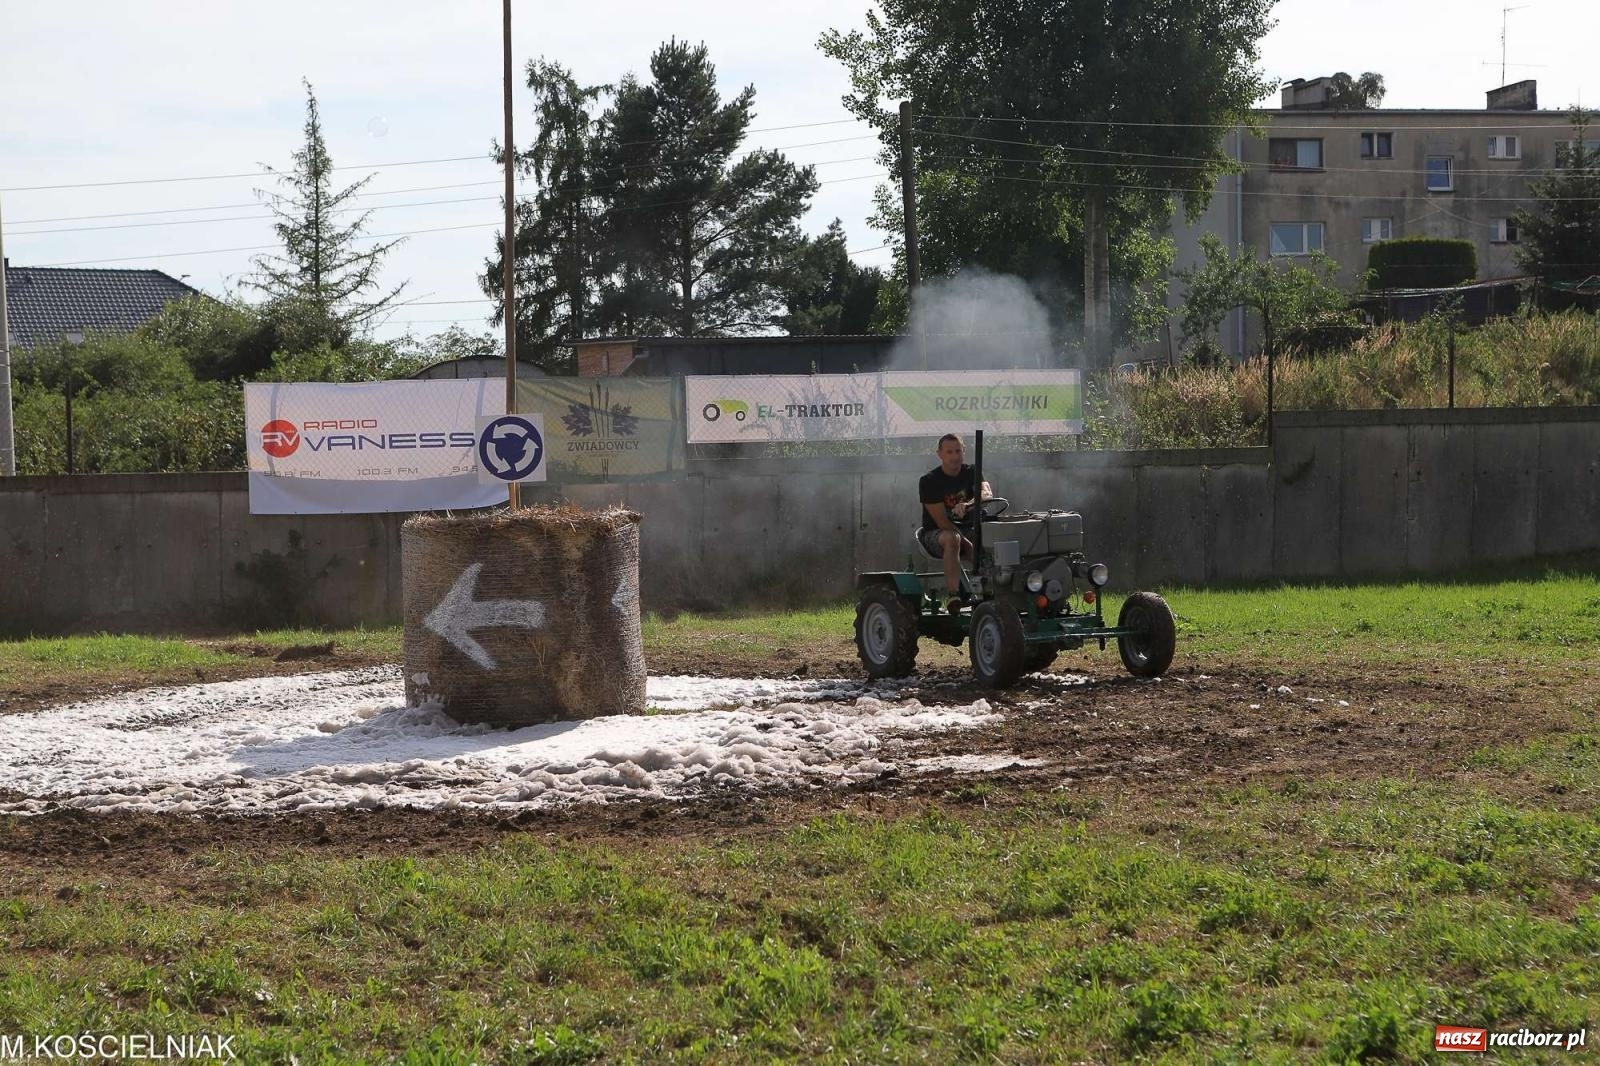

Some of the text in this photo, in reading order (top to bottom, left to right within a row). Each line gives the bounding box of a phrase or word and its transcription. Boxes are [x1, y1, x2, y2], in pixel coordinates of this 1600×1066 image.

[934, 394, 1049, 412] ROZRUSZNIKI
[757, 402, 865, 419] EL-TRAKTOR
[303, 419, 378, 431] RADIO
[304, 432, 476, 452] VANESS
[567, 440, 640, 452] ZWIADOWCY
[300, 470, 321, 478] FM
[397, 467, 419, 475] FM
